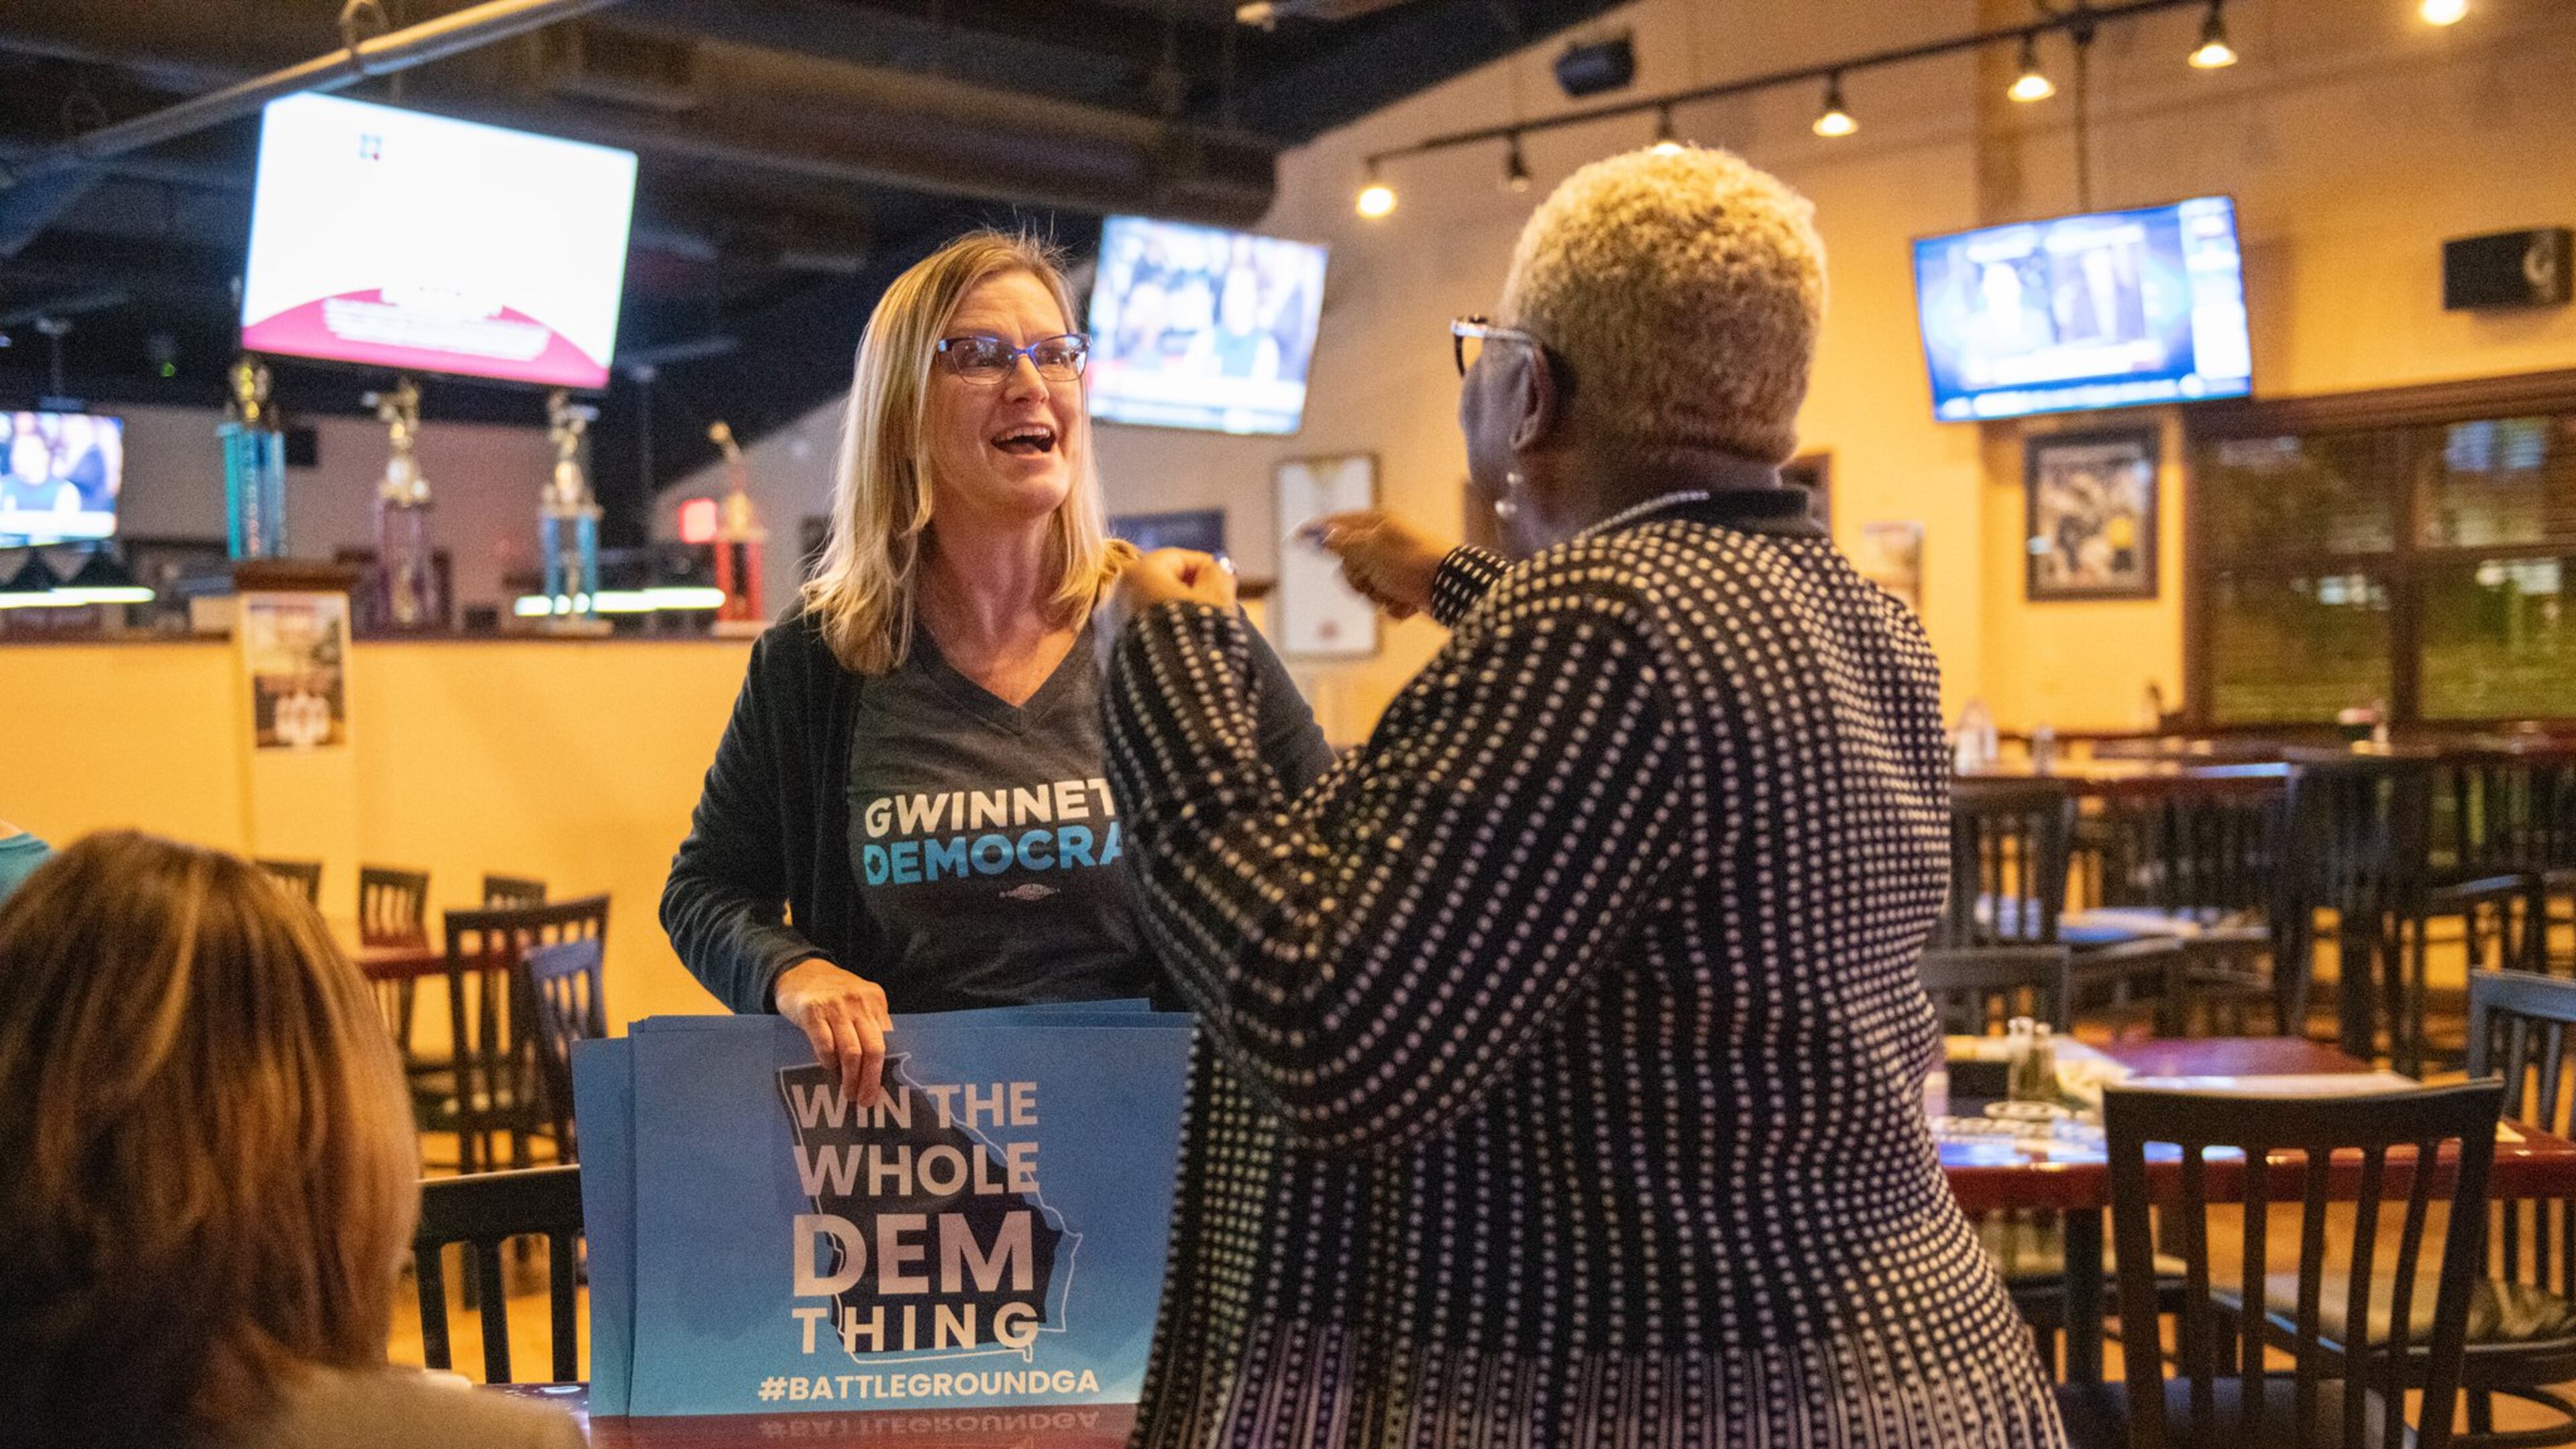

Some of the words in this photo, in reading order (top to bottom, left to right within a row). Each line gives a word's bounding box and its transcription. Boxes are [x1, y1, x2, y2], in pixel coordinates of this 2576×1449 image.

[926, 1081, 1038, 1129] THE
[792, 1142, 1040, 1196] WHOLE
[793, 1210, 1034, 1297] DEM
[792, 1301, 1039, 1354] THING
[757, 1369, 1100, 1401] #BATTLEGROUNDGA
